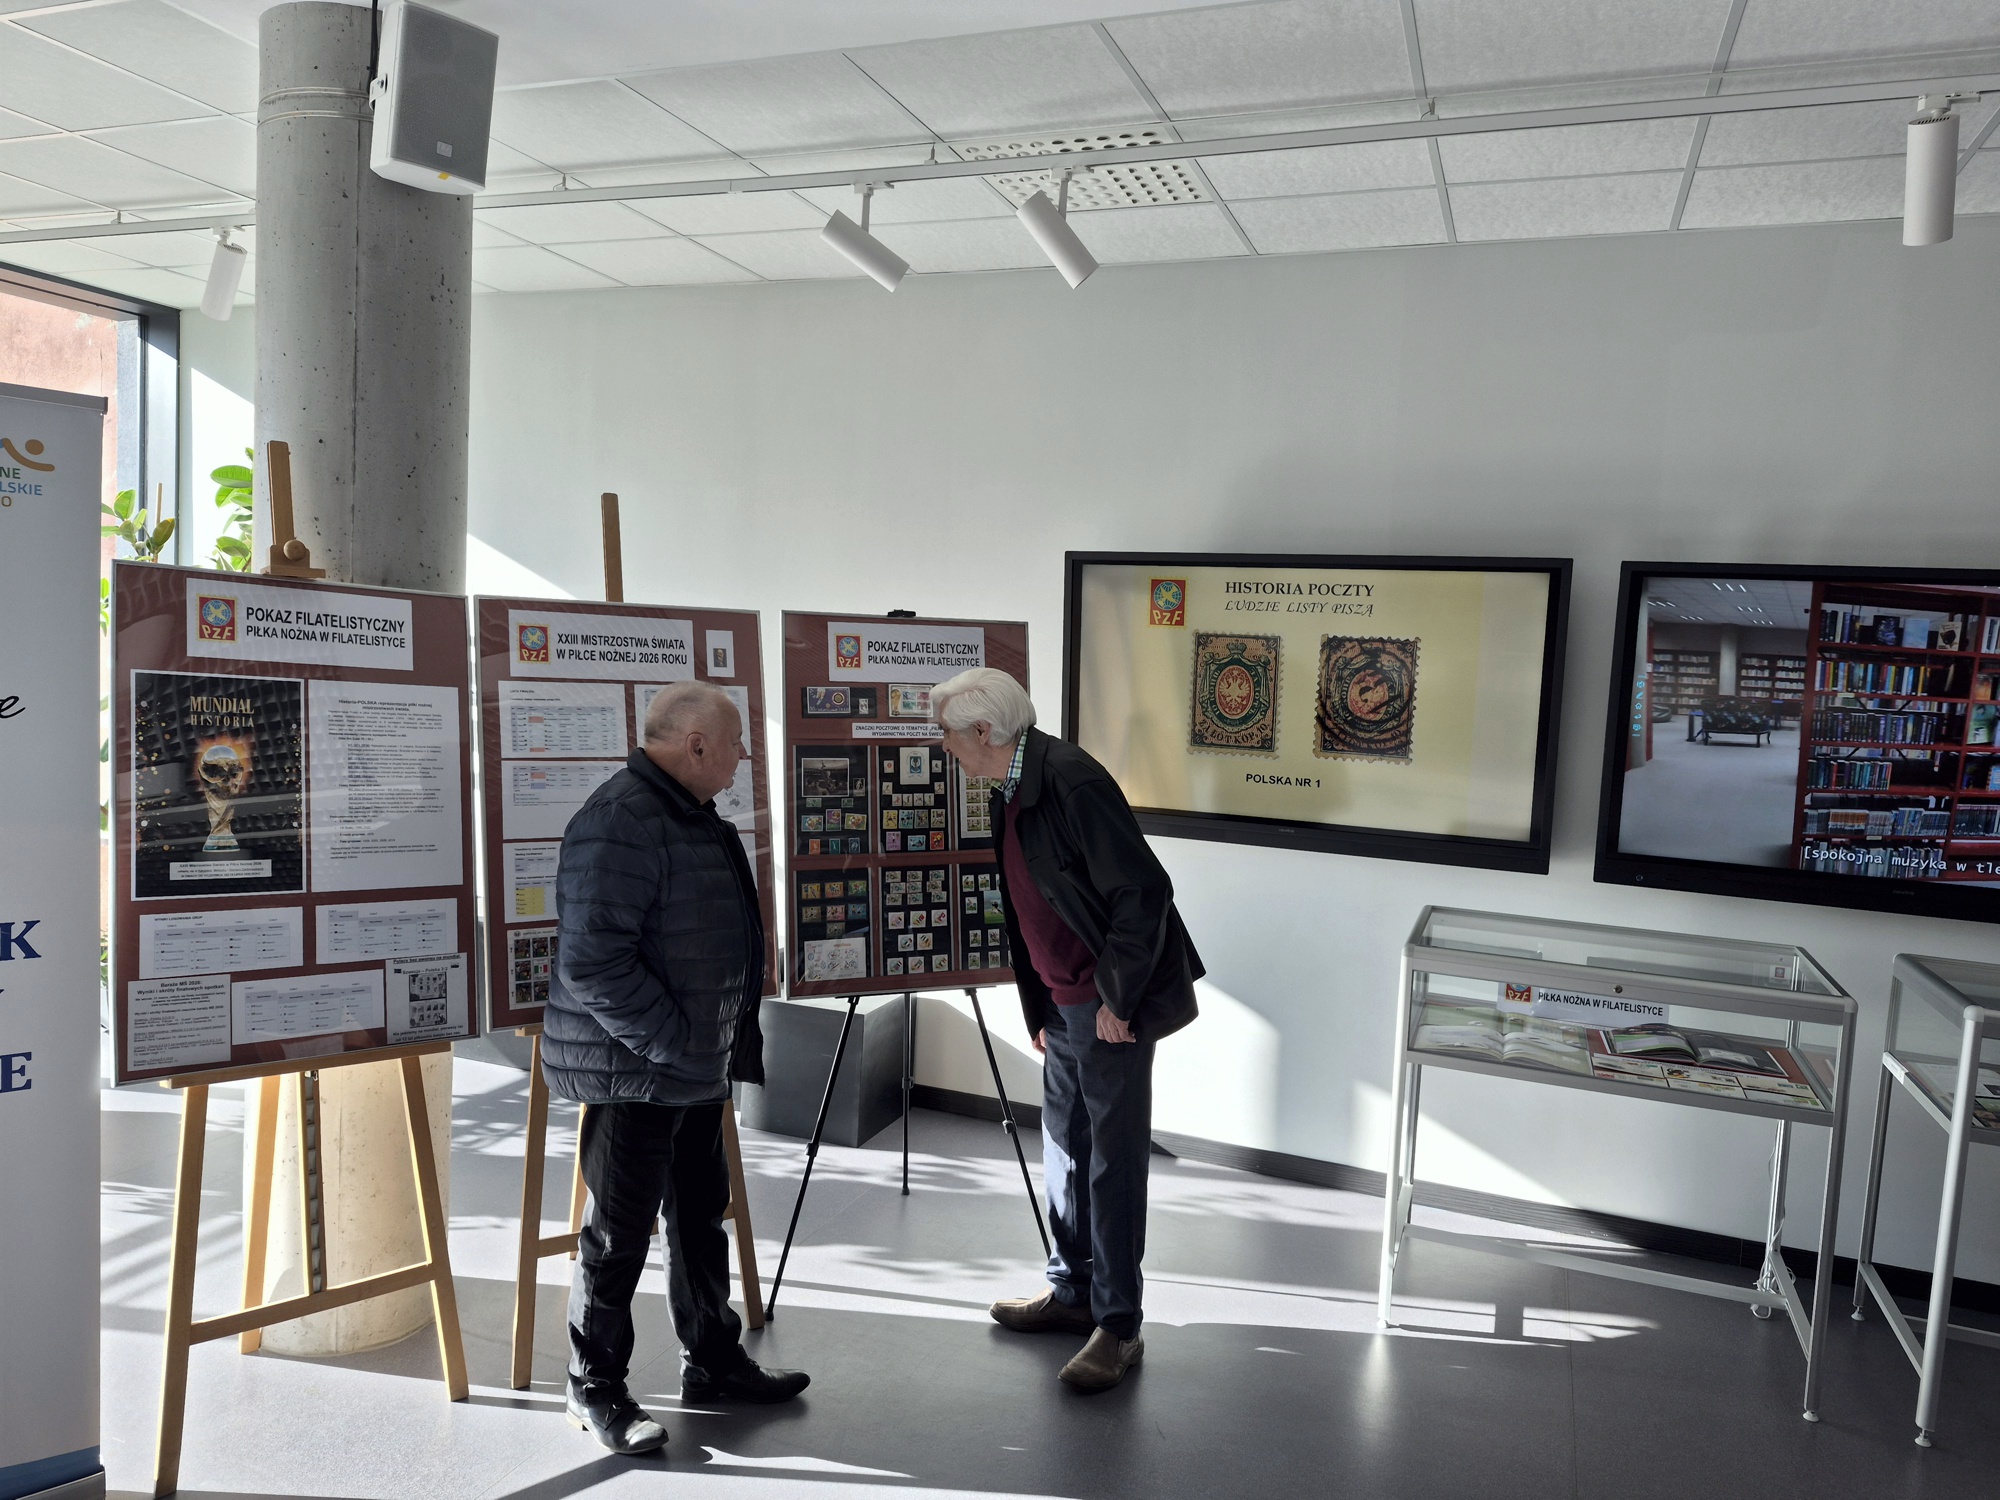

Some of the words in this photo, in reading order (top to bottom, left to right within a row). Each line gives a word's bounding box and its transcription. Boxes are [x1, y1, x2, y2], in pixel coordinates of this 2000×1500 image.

[1225, 581, 1303, 596] HISTORIA
[1308, 583, 1375, 597] POCZTY
[1224, 599, 1280, 612] LUDZIE
[1286, 601, 1328, 613] LISTY
[1331, 602, 1374, 617] PISZĄ
[246, 607, 292, 624] POKAZ
[295, 611, 405, 633] FILATELISTYCZNY
[246, 625, 278, 639] PIŁKA
[280, 627, 317, 642] NOŻNA
[319, 631, 330, 642] W
[332, 632, 406, 648] FILATELISTYCE
[557, 633, 579, 645] XXIII
[581, 635, 649, 648] MISTRZOSTWA
[651, 636, 685, 650] ŚWIATA
[867, 641, 899, 653] POKAZ
[901, 642, 979, 655] FILATELISTYCZNY
[556, 649, 566, 660] W
[569, 650, 596, 661] PIŁCE
[599, 649, 637, 663] NOŻNEJ
[639, 652, 659, 663] 2026
[661, 654, 687, 665] ROKU
[868, 655, 890, 665] PIŁKA
[891, 654, 917, 665] NOŻNA
[918, 657, 926, 665] W
[926, 657, 980, 667] FILATELISTYCE
[190, 696, 255, 714] MUNDIAL
[190, 714, 255, 728] HISTORIA
[1246, 773, 1292, 786] POLSKA
[1295, 777, 1311, 787] NR
[1316, 779, 1321, 788] 1
[1804, 846, 1883, 865] [spokojna
[1891, 855, 1947, 871] muzyka
[1956, 862, 1967, 872] w
[1976, 862, 2000, 875] tle
[1538, 991, 1562, 1003] PIŁKA
[1563, 994, 1591, 1007] NOŻNA
[1592, 999, 1601, 1008] W
[1602, 1000, 1664, 1016] FILATELISTYCE
